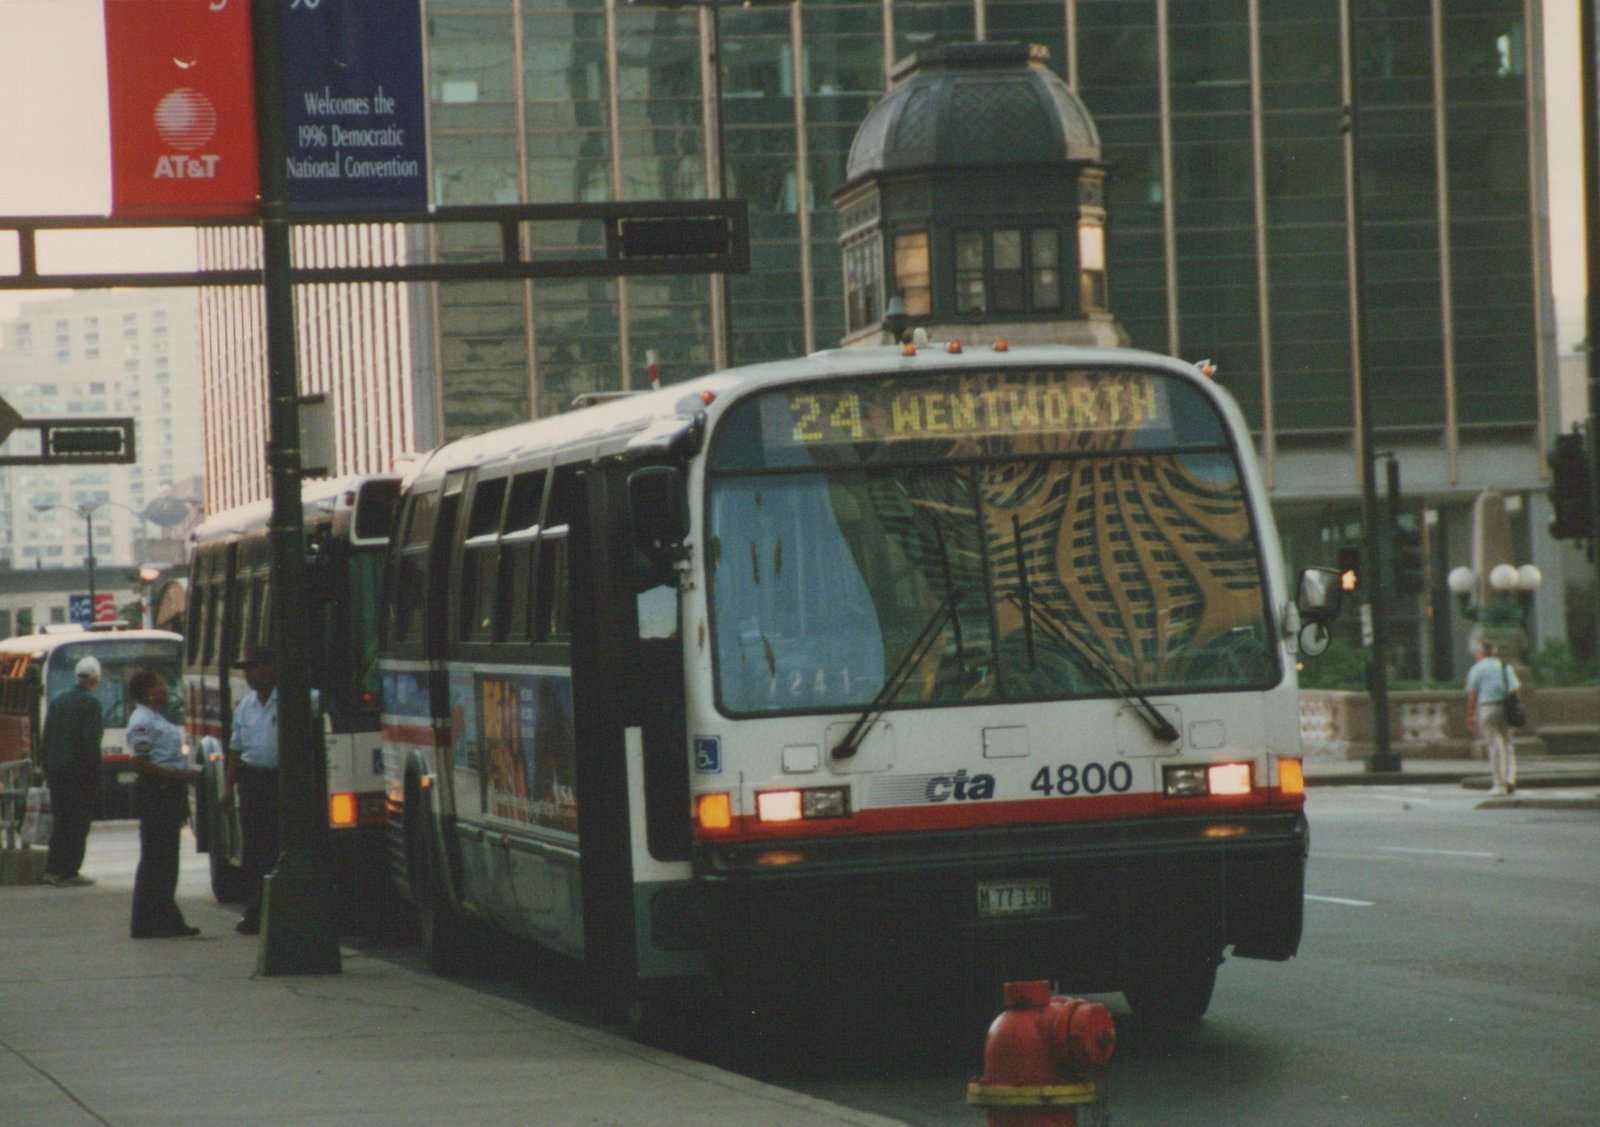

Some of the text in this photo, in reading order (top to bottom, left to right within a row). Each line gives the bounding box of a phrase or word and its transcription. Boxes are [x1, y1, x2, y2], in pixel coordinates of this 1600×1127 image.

[304, 85, 395, 115] Welcomes the
[299, 123, 404, 147] 1996 Democratic
[153, 154, 220, 178] AT&T
[286, 150, 418, 178] National Convention
[790, 383, 1157, 440] 24 WENTWORTH
[926, 769, 996, 802] cta
[1030, 761, 1133, 796] 4800
[996, 887, 1014, 908] 77
